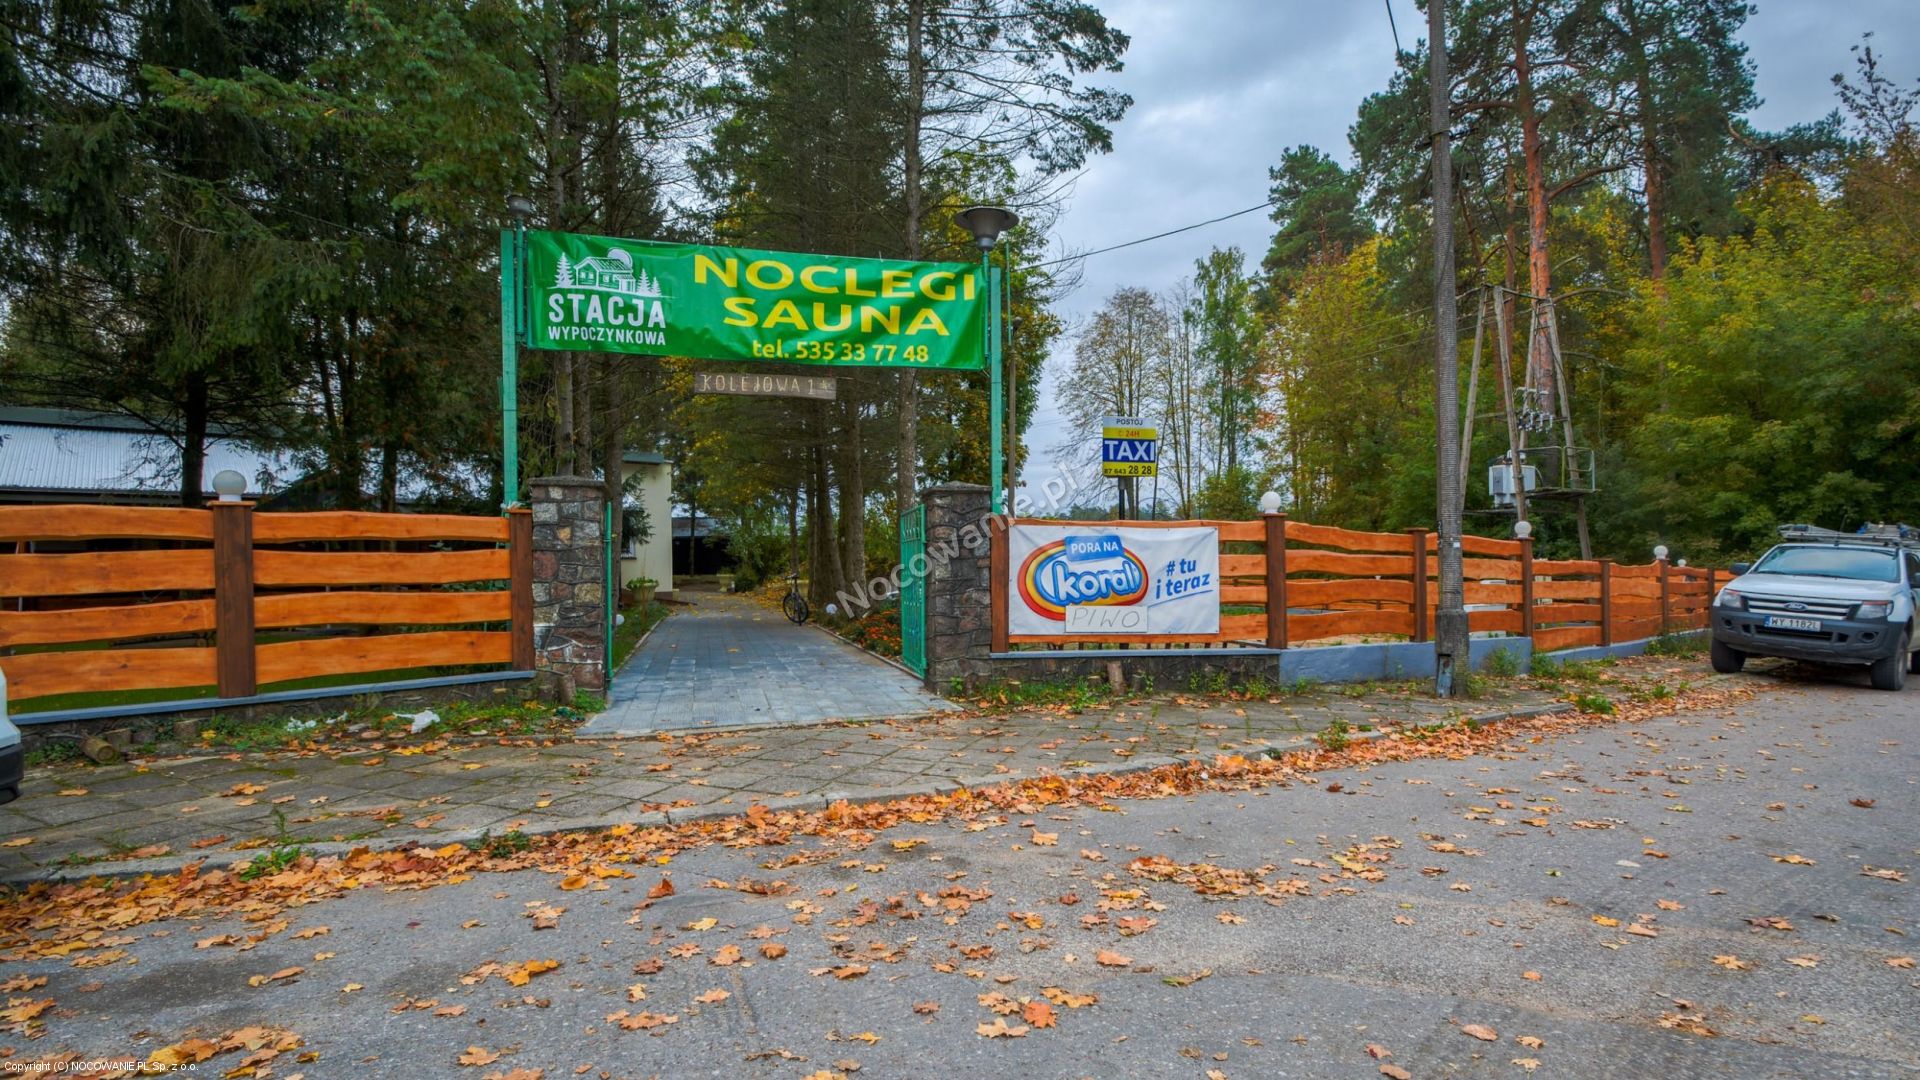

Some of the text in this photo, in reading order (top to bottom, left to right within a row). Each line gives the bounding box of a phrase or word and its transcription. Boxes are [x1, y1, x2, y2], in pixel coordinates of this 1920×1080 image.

[694, 254, 976, 302] NOCLEGI
[548, 293, 666, 328] STACJA
[723, 296, 950, 336] SAUNA
[548, 326, 666, 346] WYPOCZYNKOWA
[752, 339, 929, 363] tel. 535 33 77 48
[699, 374, 801, 393] KOLEJOWA
[1104, 440, 1155, 461] TAXI
[1128, 465, 1139, 475] 28
[1141, 465, 1152, 475] 28
[1070, 541, 1119, 554] PORA NA
[1179, 558, 1197, 574] tu
[1055, 560, 1135, 602] koral
[1156, 573, 1210, 600] i teraz
[1071, 606, 1140, 628] PIWO
[1771, 617, 1785, 625] WY
